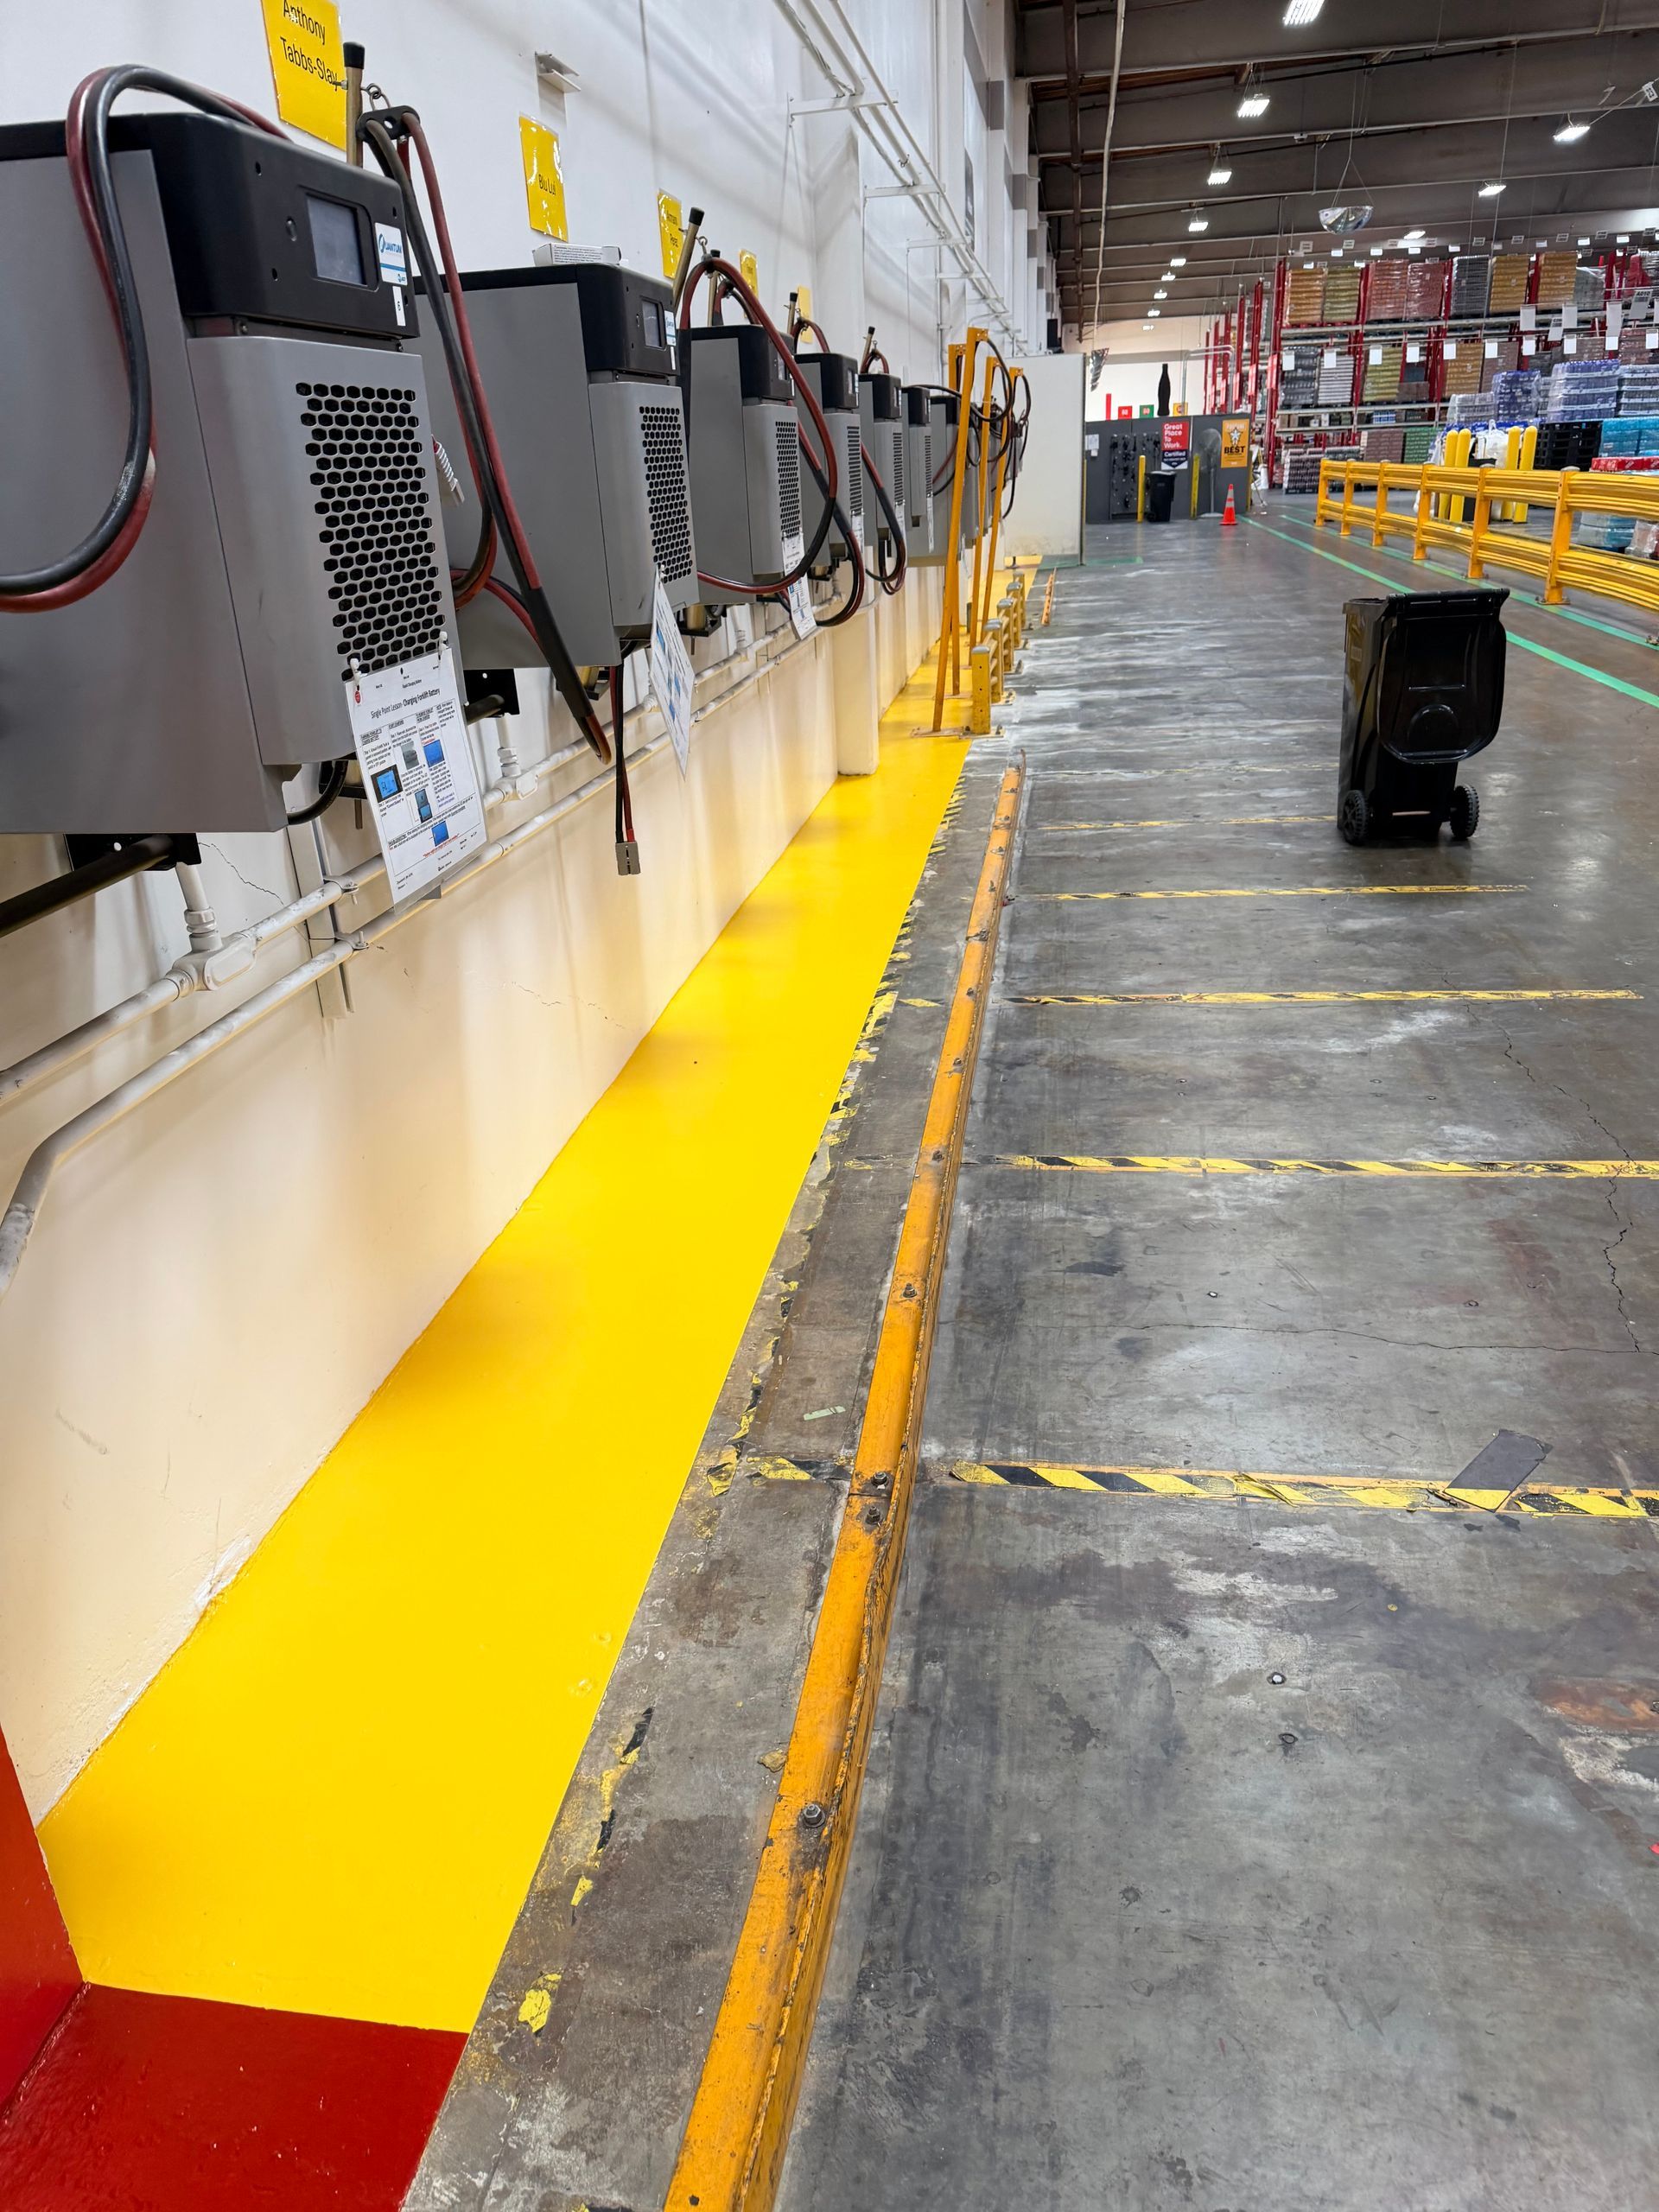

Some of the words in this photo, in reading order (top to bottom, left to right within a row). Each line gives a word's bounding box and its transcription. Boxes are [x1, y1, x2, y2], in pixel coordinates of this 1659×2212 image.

[283, 0, 325, 45] Anthony
[280, 36, 337, 92] Tabbs-Slay
[378, 233, 402, 253] QUANTUM
[1224, 445, 1245, 454] BEST
[371, 709, 382, 719] Single
[381, 705, 391, 715] Point
[403, 695, 417, 707] Charging
[416, 690, 429, 702] Forklift
[428, 688, 441, 697] Battery
